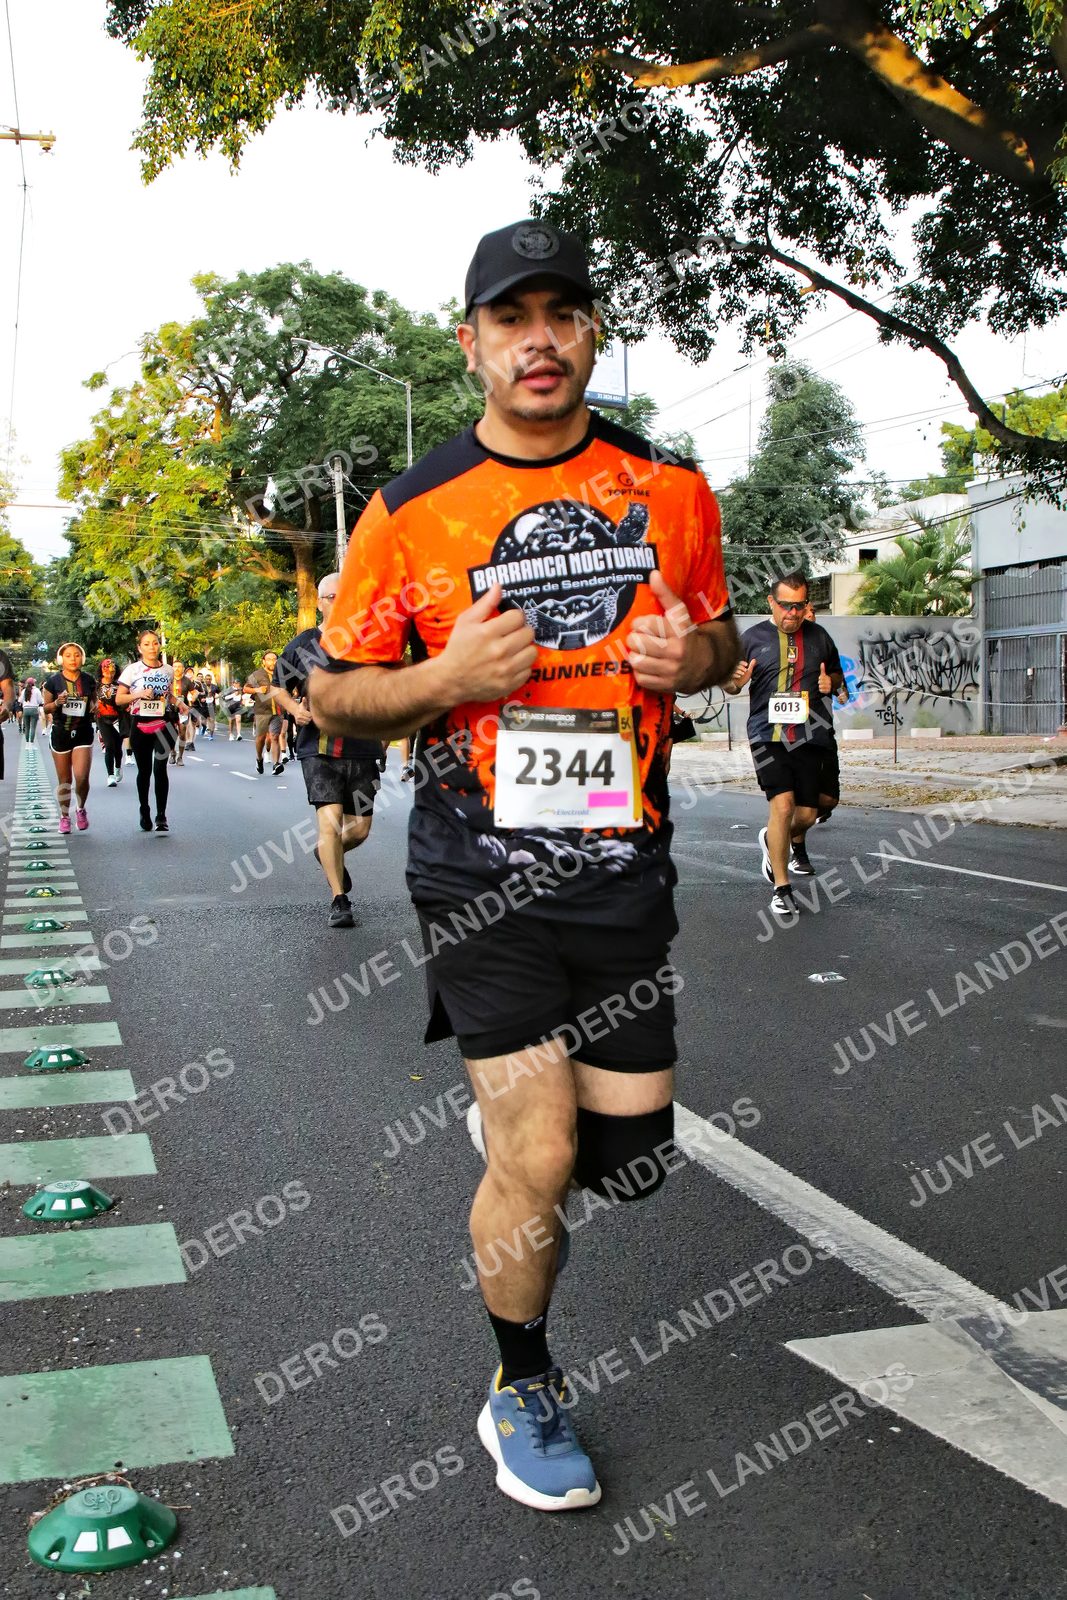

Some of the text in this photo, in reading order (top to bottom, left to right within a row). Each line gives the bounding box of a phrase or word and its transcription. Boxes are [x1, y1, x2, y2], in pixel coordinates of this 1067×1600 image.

[607, 488, 651, 498] TOPTIME
[473, 546, 656, 594] BARRANCA NOCTURNA
[501, 573, 644, 600] Grupo de Senderismo
[529, 658, 634, 684] RUNNERS
[143, 702, 160, 710] 3471
[773, 701, 800, 712] 6013
[515, 746, 615, 786] 2344
